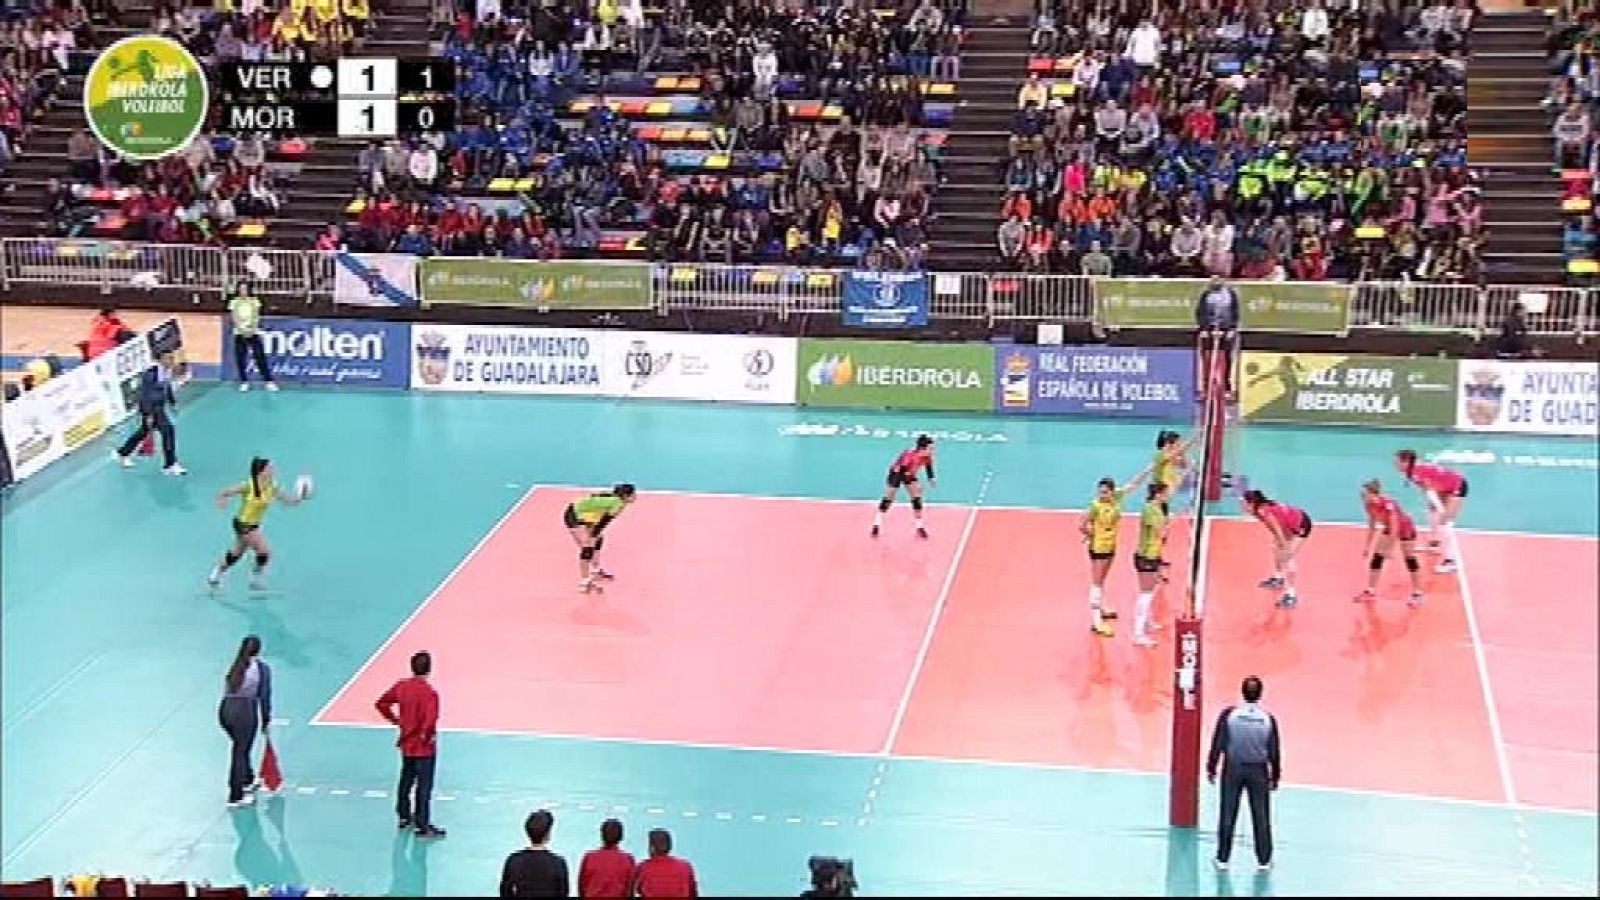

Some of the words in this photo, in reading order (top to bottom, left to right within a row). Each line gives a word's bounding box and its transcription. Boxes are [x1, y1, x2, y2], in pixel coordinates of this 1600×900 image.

[464, 333, 591, 359] AYUNTAMIENTO
[454, 361, 475, 382] DE
[481, 361, 602, 386] GUADALAJARA
[857, 364, 983, 389] IBERDROLA
[1305, 368, 1340, 386] ALL
[1343, 368, 1394, 389] STAR
[1296, 391, 1401, 413] IBERDROLA
[1509, 400, 1532, 423] DE
